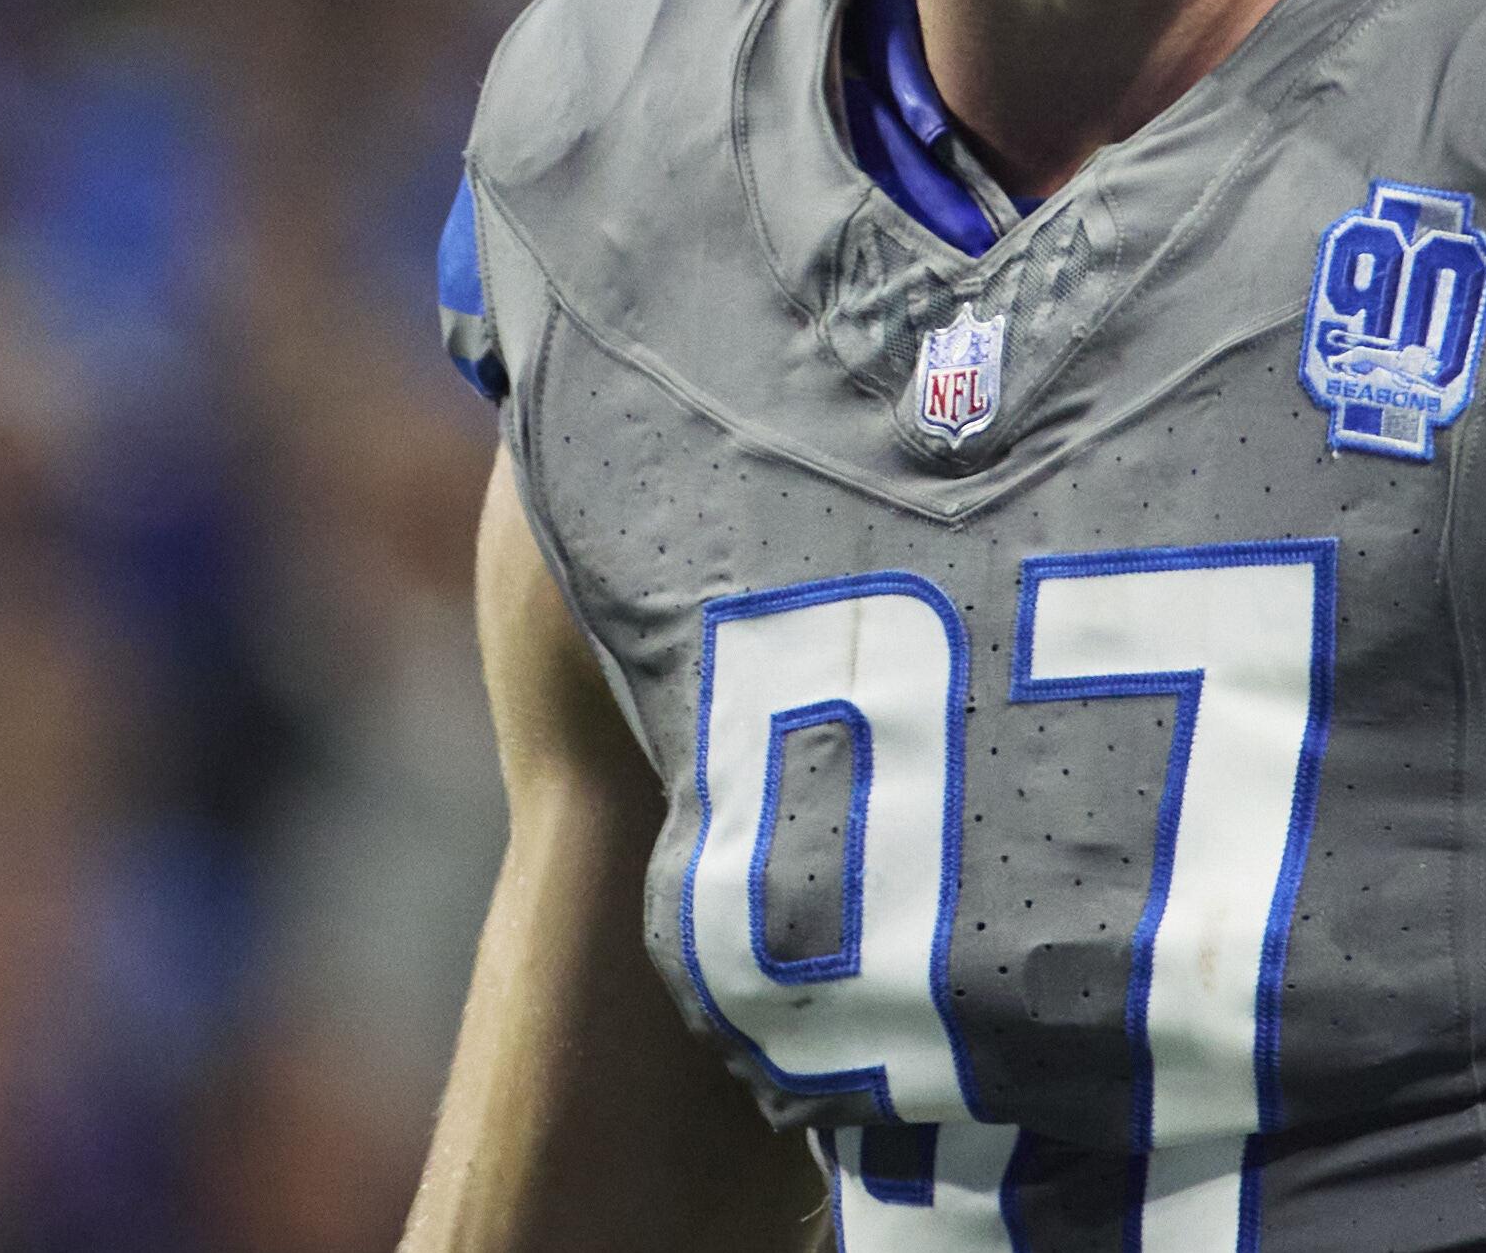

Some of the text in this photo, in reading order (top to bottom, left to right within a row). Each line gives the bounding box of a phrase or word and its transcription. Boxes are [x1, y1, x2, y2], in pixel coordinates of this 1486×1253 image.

[928, 369, 984, 422] NFL
[1326, 378, 1441, 413] SEASONS
[680, 536, 1339, 1253] 97
